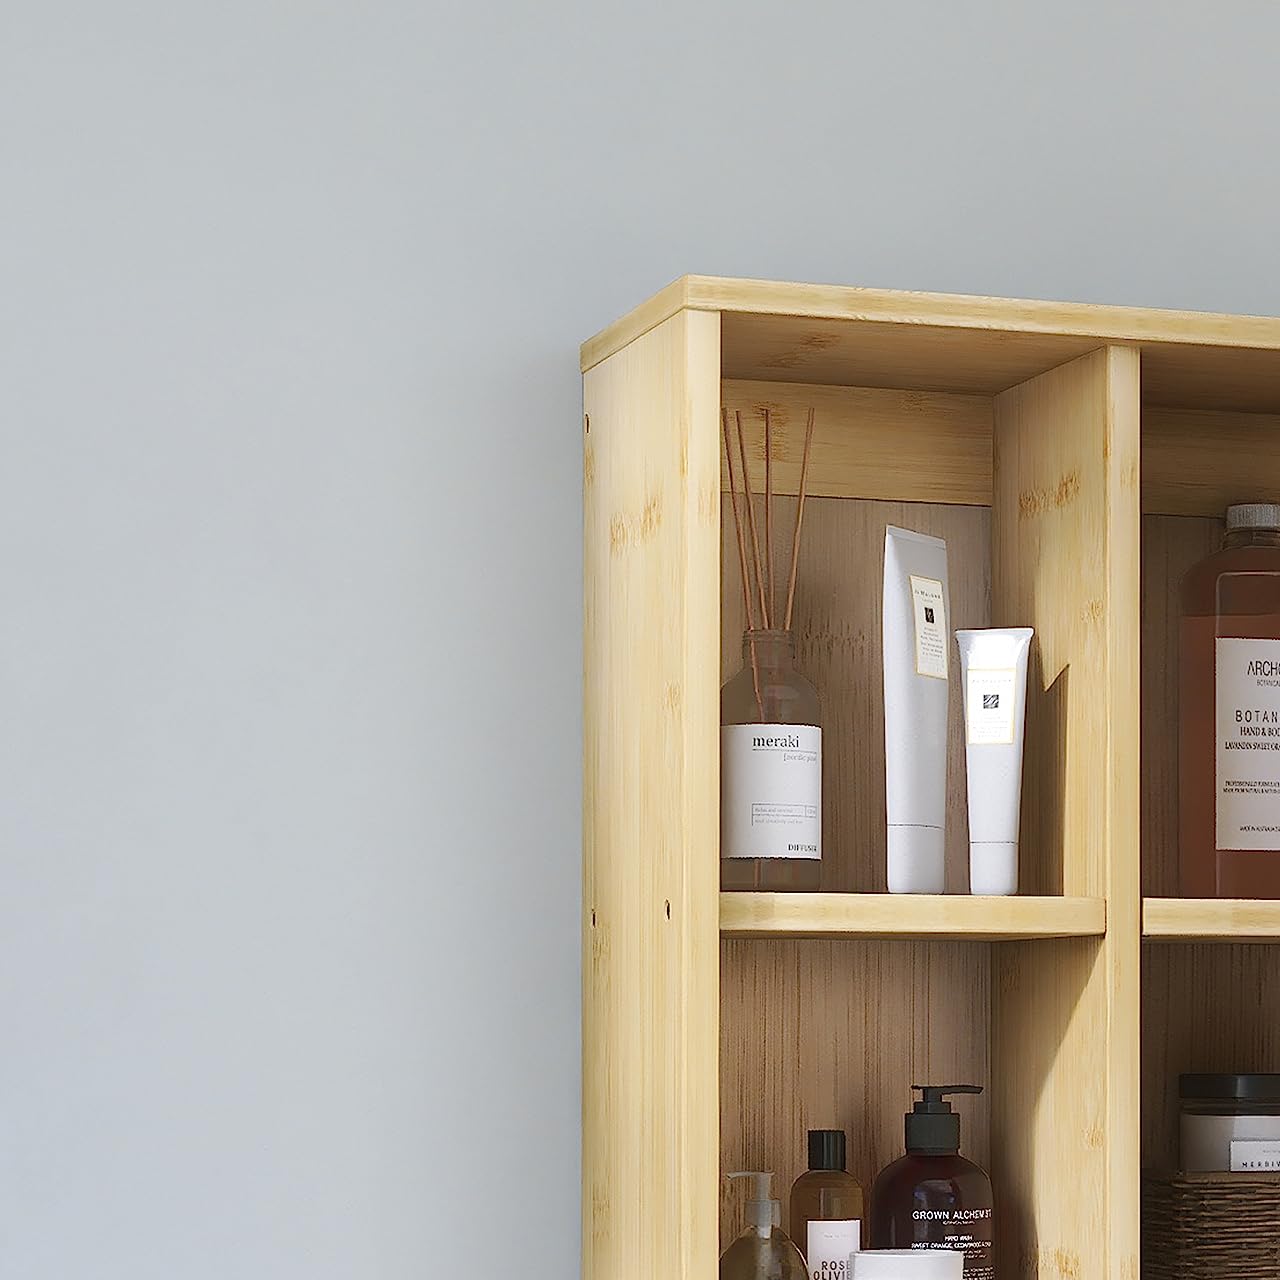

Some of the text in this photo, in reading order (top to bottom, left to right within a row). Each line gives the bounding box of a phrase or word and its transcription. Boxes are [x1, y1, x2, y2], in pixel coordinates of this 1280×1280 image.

[1240, 726, 1260, 737] HAND
[752, 735, 799, 748] meraki
[912, 1210, 950, 1220] GROWN
[813, 1271, 852, 1280] OLIVIE
